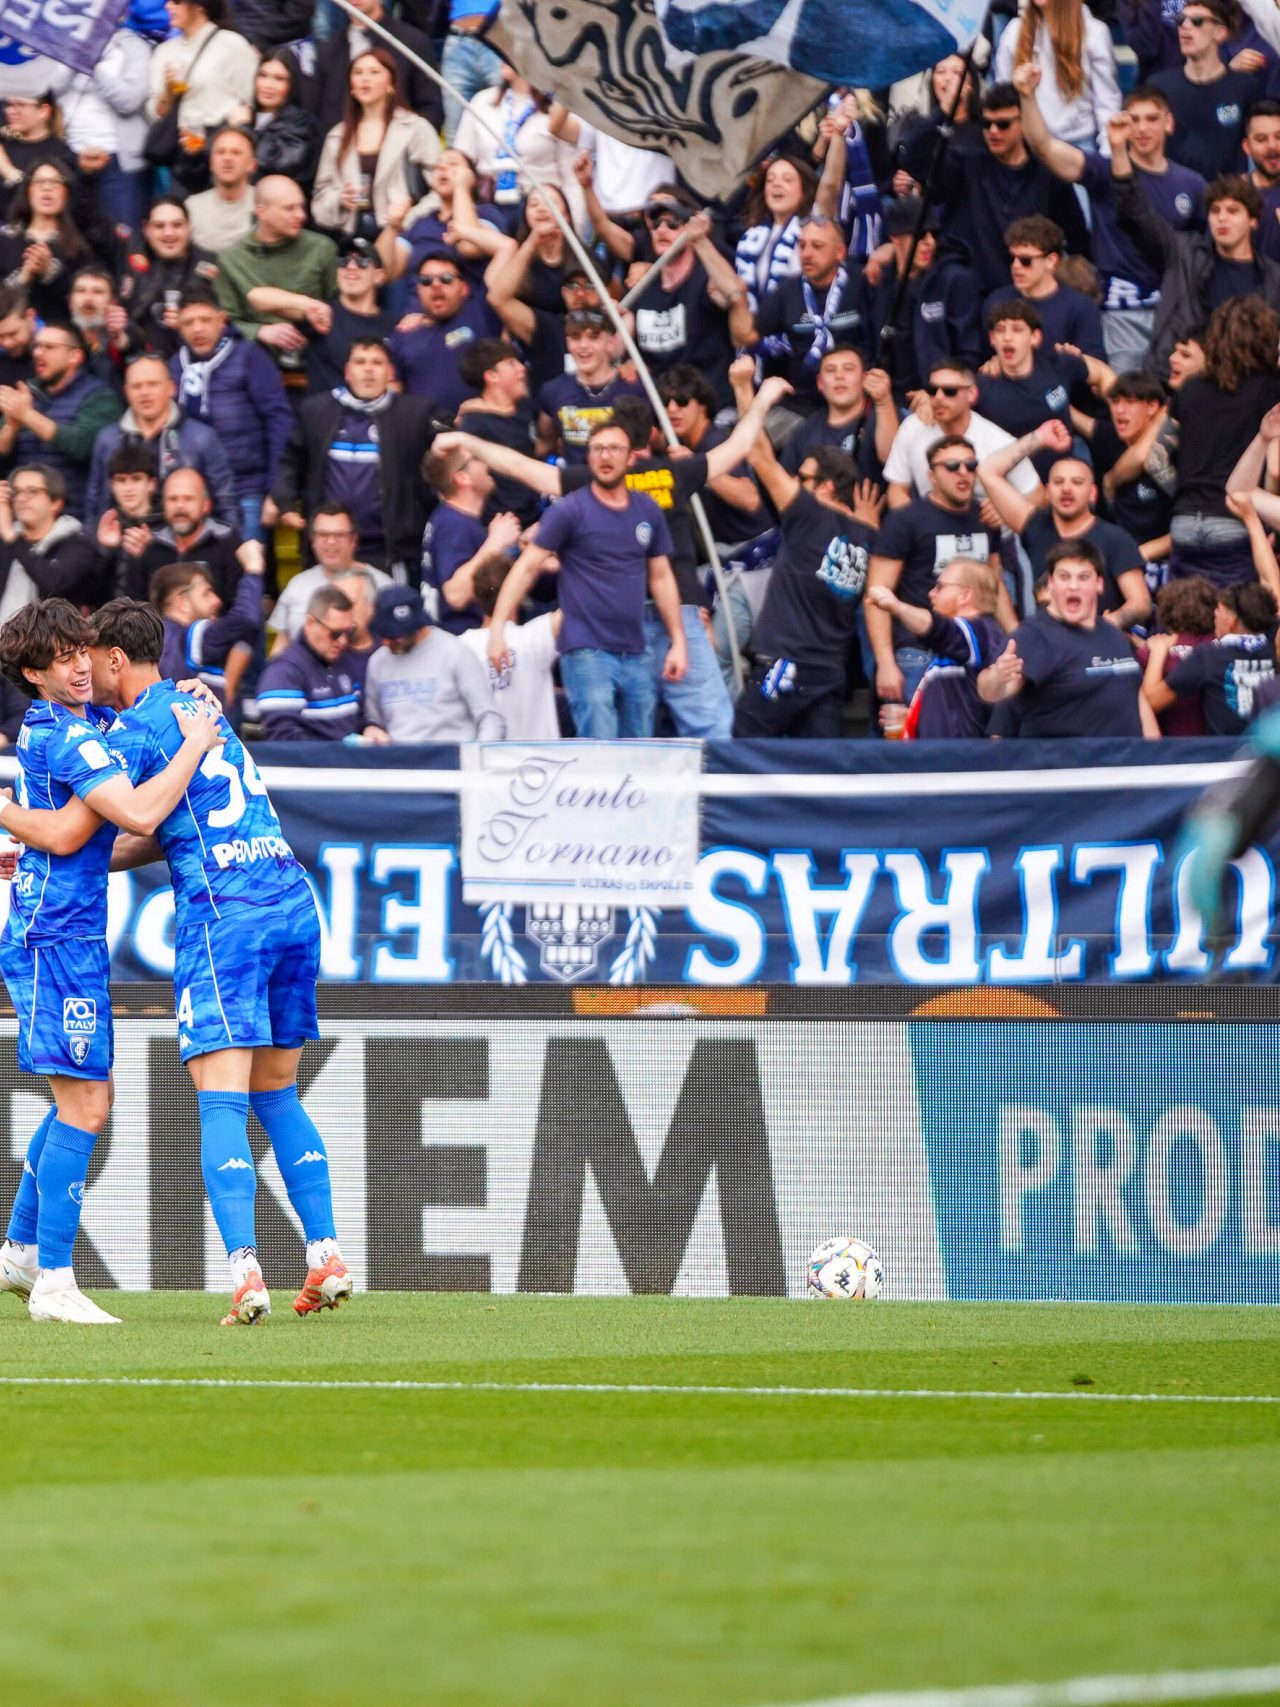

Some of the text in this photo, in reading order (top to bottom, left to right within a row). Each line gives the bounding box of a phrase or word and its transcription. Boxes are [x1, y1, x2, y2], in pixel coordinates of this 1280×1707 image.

[510, 756, 650, 809] Tanto
[477, 810, 674, 867] Tornano
[685, 840, 1273, 983] ULTRAS
[65, 1020, 95, 1029] ITALY
[1001, 1104, 1280, 1253] PROD
